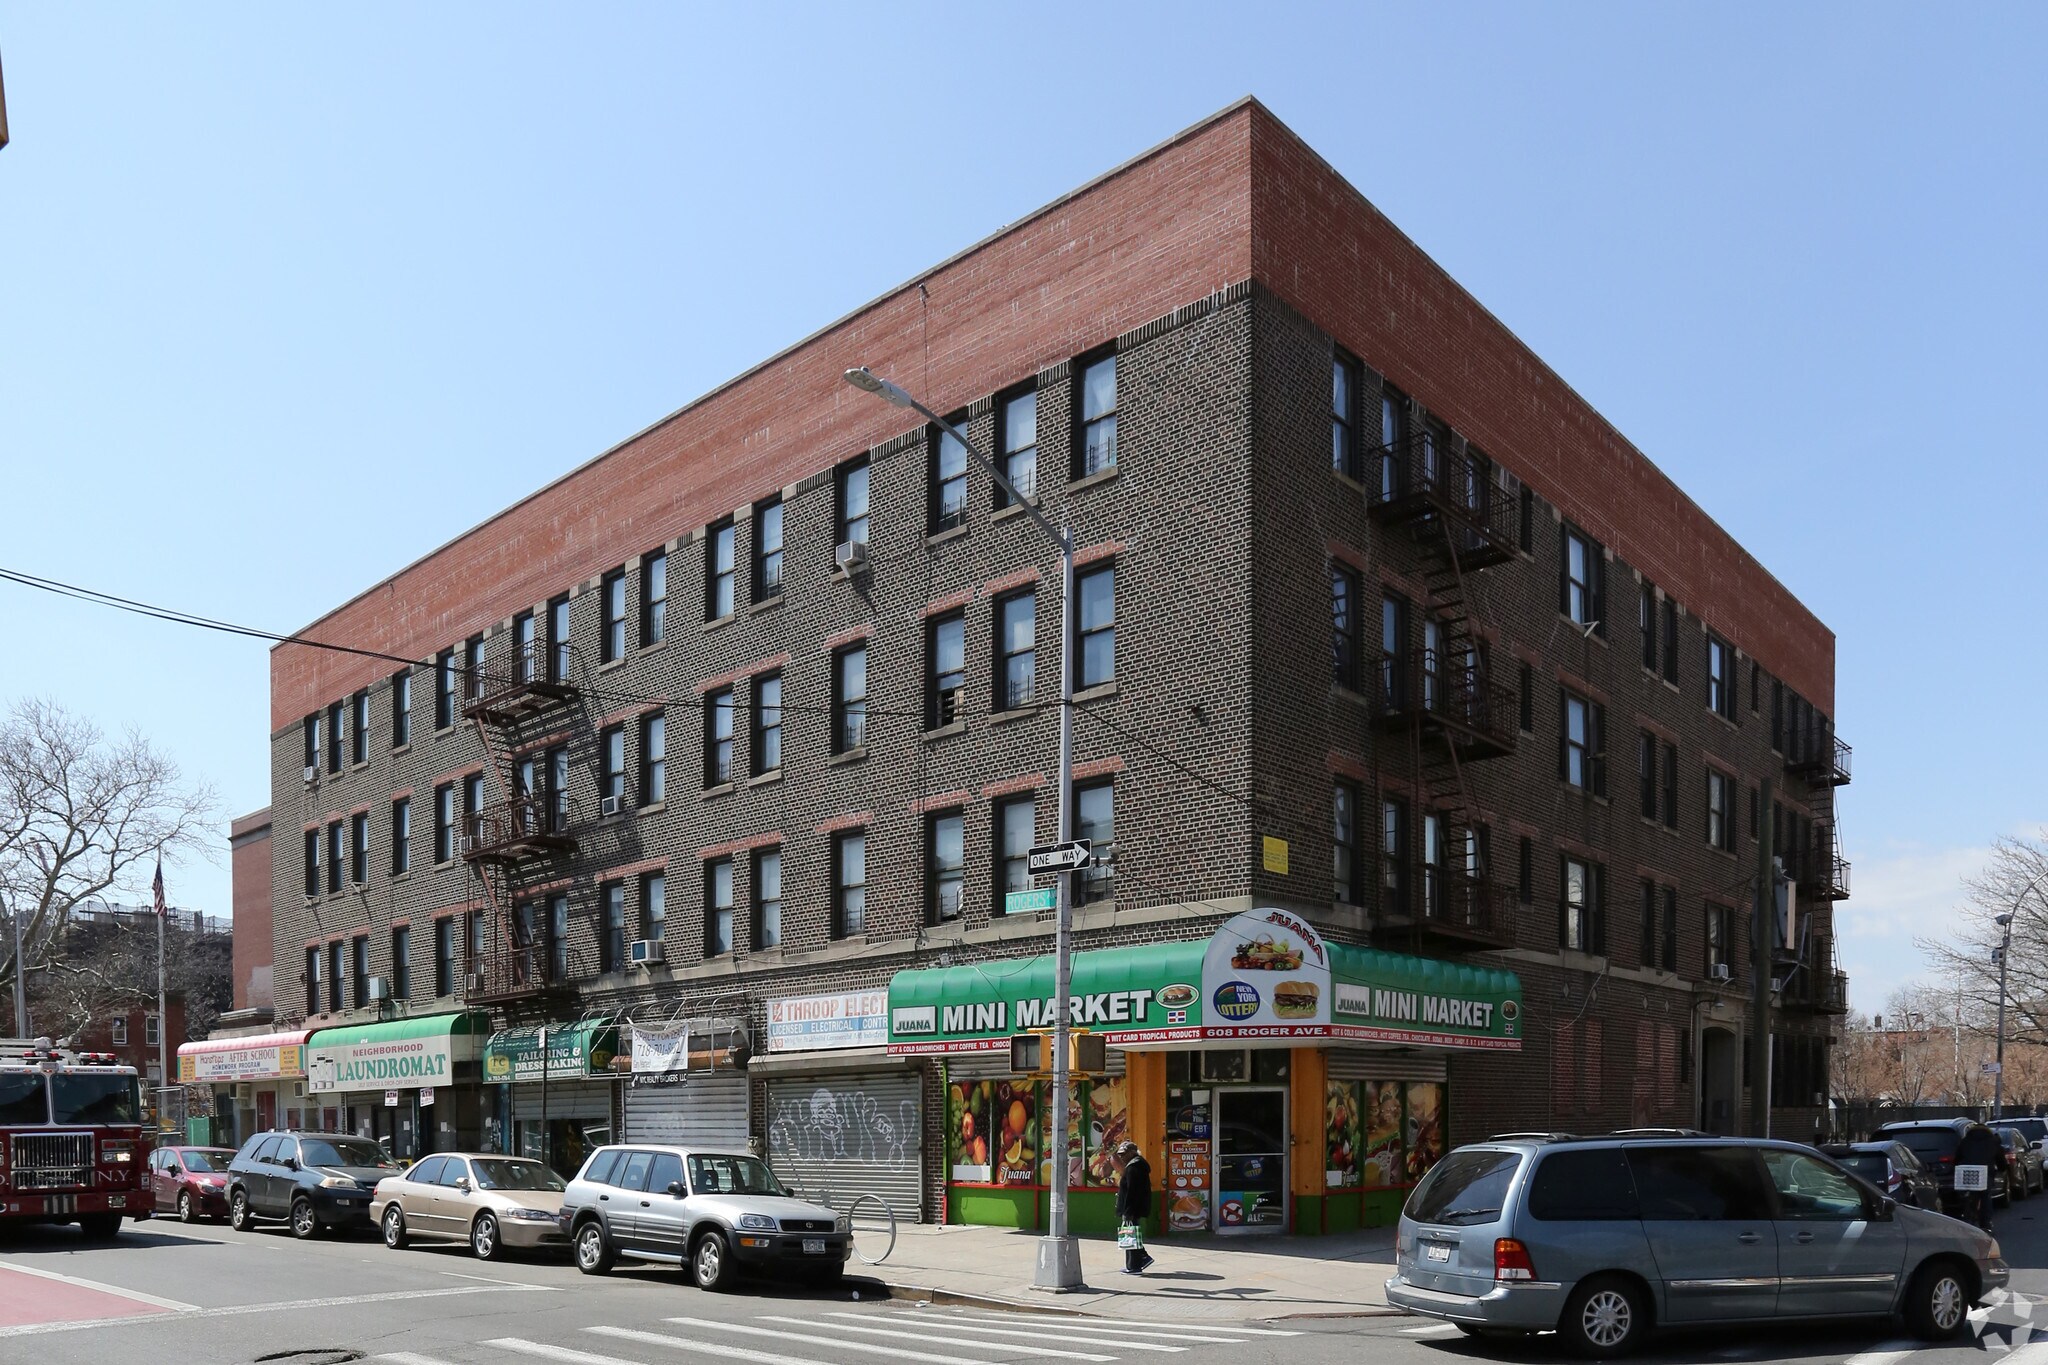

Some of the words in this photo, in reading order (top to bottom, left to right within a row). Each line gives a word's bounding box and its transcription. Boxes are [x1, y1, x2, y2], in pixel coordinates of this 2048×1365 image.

[1032, 854, 1050, 867] ONE
[1062, 849, 1081, 862] WAY
[1007, 892, 1046, 911] ROGERS
[1266, 911, 1324, 966] JUANA
[1236, 985, 1253, 994] NEW
[1237, 993, 1257, 1003] YORK
[786, 998, 840, 1021] THROOP
[845, 995, 886, 1017] ELECT
[942, 1002, 1007, 1032] MINI
[1016, 989, 1152, 1028] MARKET
[1217, 1002, 1259, 1016] LOTTERY
[1338, 998, 1367, 1014] JUANA
[1375, 989, 1418, 1021] MINI
[1423, 995, 1494, 1029] MARKET
[772, 1023, 804, 1036] LICENSED
[811, 1020, 853, 1033] ELECTRICAL
[862, 1017, 888, 1029] CONTR
[895, 1020, 931, 1032] JUANA
[1206, 1028, 1233, 1037] 608
[1238, 1028, 1291, 1036] ROGER
[1293, 1027, 1328, 1035] AVE.
[1122, 1033, 1138, 1042] CARD
[1139, 1032, 1167, 1041] TROPICAL
[1168, 1030, 1200, 1039] PRODUCTS
[353, 1043, 424, 1057] NEIGHBORHOOD
[517, 1048, 569, 1061] TAILORING
[572, 1047, 581, 1057] &
[915, 1044, 945, 1052] SANDWICHES
[229, 1052, 248, 1063] AFTER
[251, 1048, 276, 1061] SCHOOL
[490, 1058, 506, 1067] TC
[239, 1061, 260, 1069] PROGRAM
[336, 1053, 446, 1082] LAUNDROMAT
[515, 1057, 585, 1072] DRESSMAKING
[422, 1090, 433, 1098] ATM
[1194, 1124, 1208, 1133] EBT
[96, 1170, 132, 1182] N.Y.
[1171, 1168, 1207, 1176] SCHOLARS
